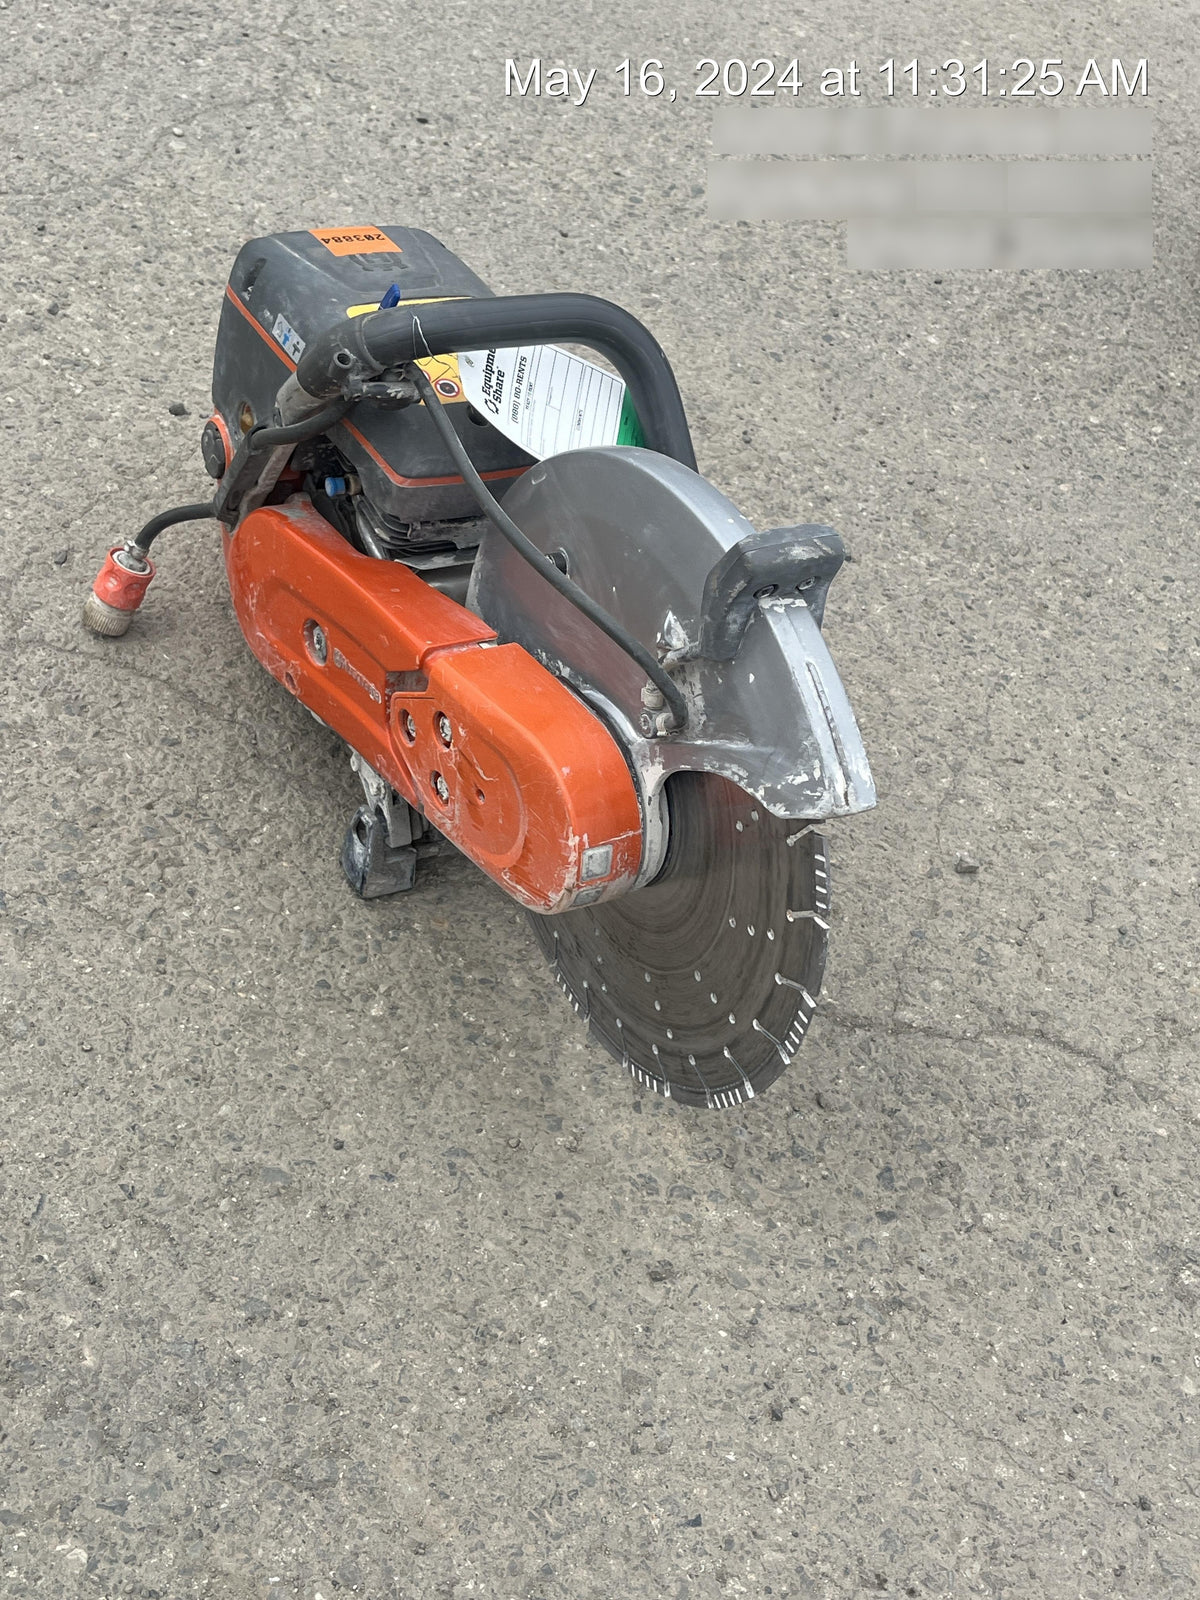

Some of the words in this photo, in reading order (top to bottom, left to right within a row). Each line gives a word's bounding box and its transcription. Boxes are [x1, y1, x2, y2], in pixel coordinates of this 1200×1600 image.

[321, 233, 385, 244] 203884
[481, 348, 497, 397] Equipme
[492, 369, 505, 404] Share
